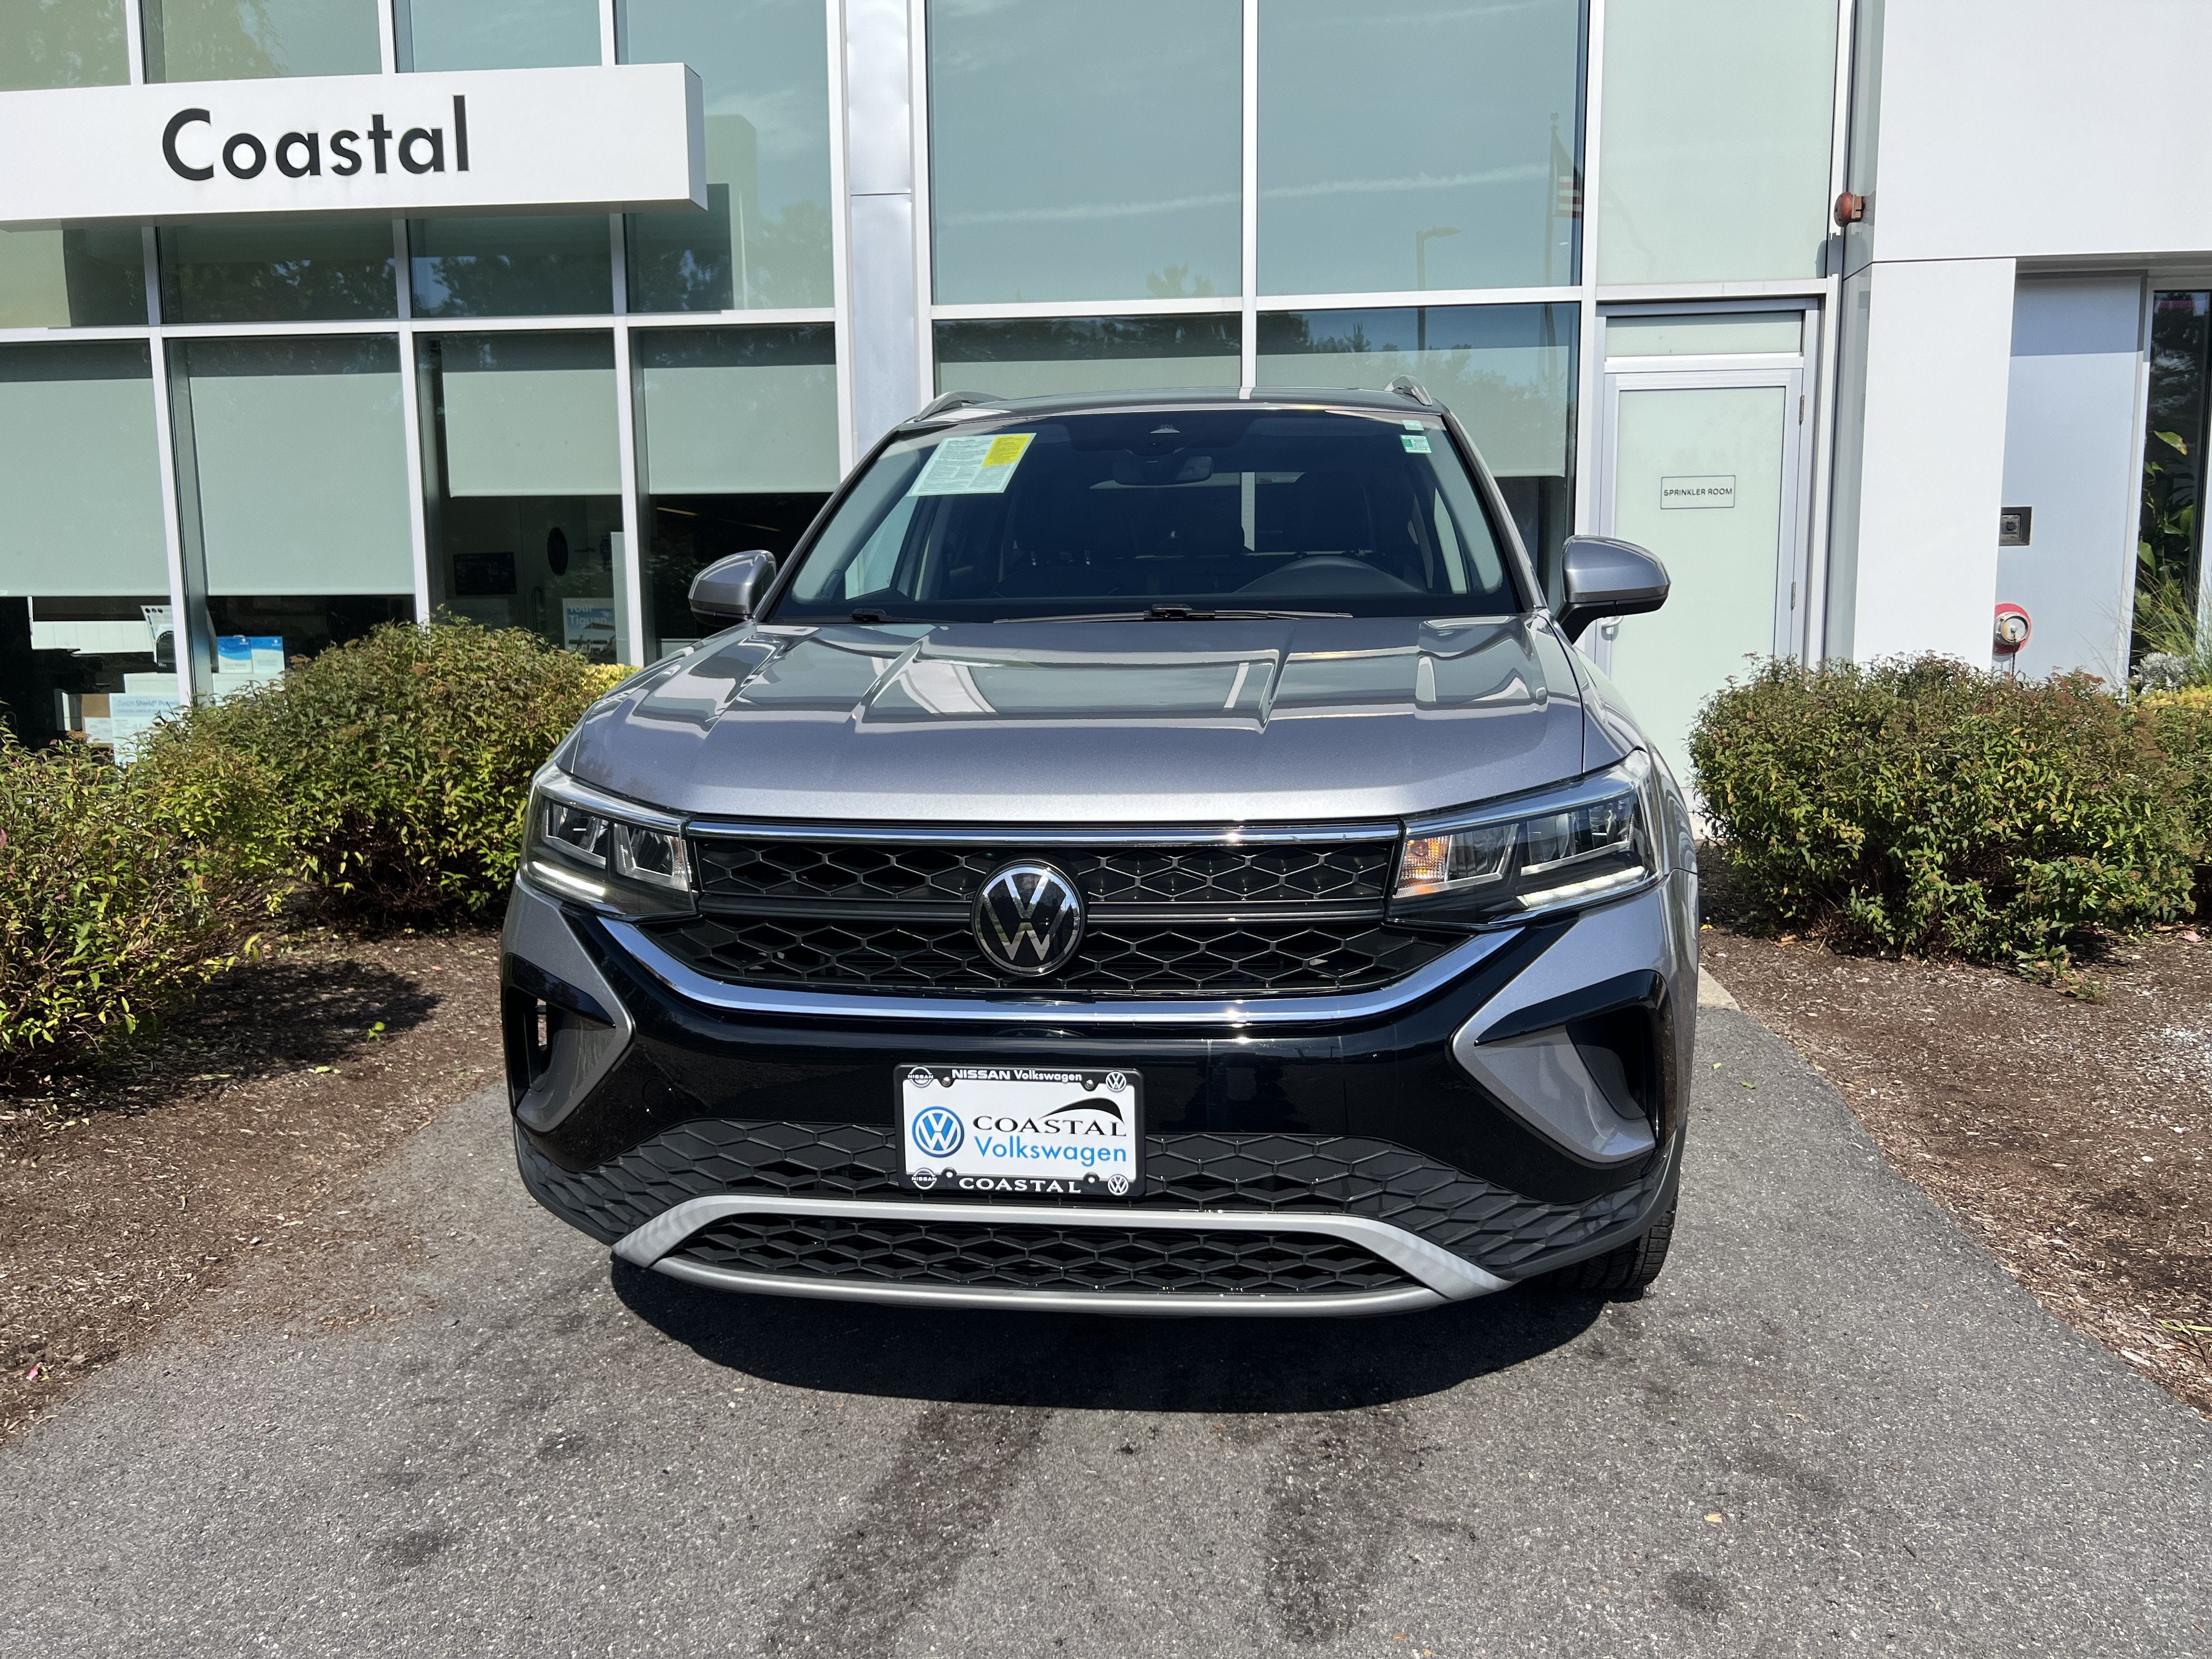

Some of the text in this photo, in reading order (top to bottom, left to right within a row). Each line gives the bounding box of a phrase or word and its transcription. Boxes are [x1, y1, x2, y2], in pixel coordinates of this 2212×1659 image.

[162, 94, 470, 181] Coastal
[951, 1069, 1082, 1084] NISSAN Volkswagen
[973, 1115, 1126, 1137] COASTAL
[974, 1135, 1127, 1167] Volkswagen
[958, 1177, 1081, 1193] COASTAL
